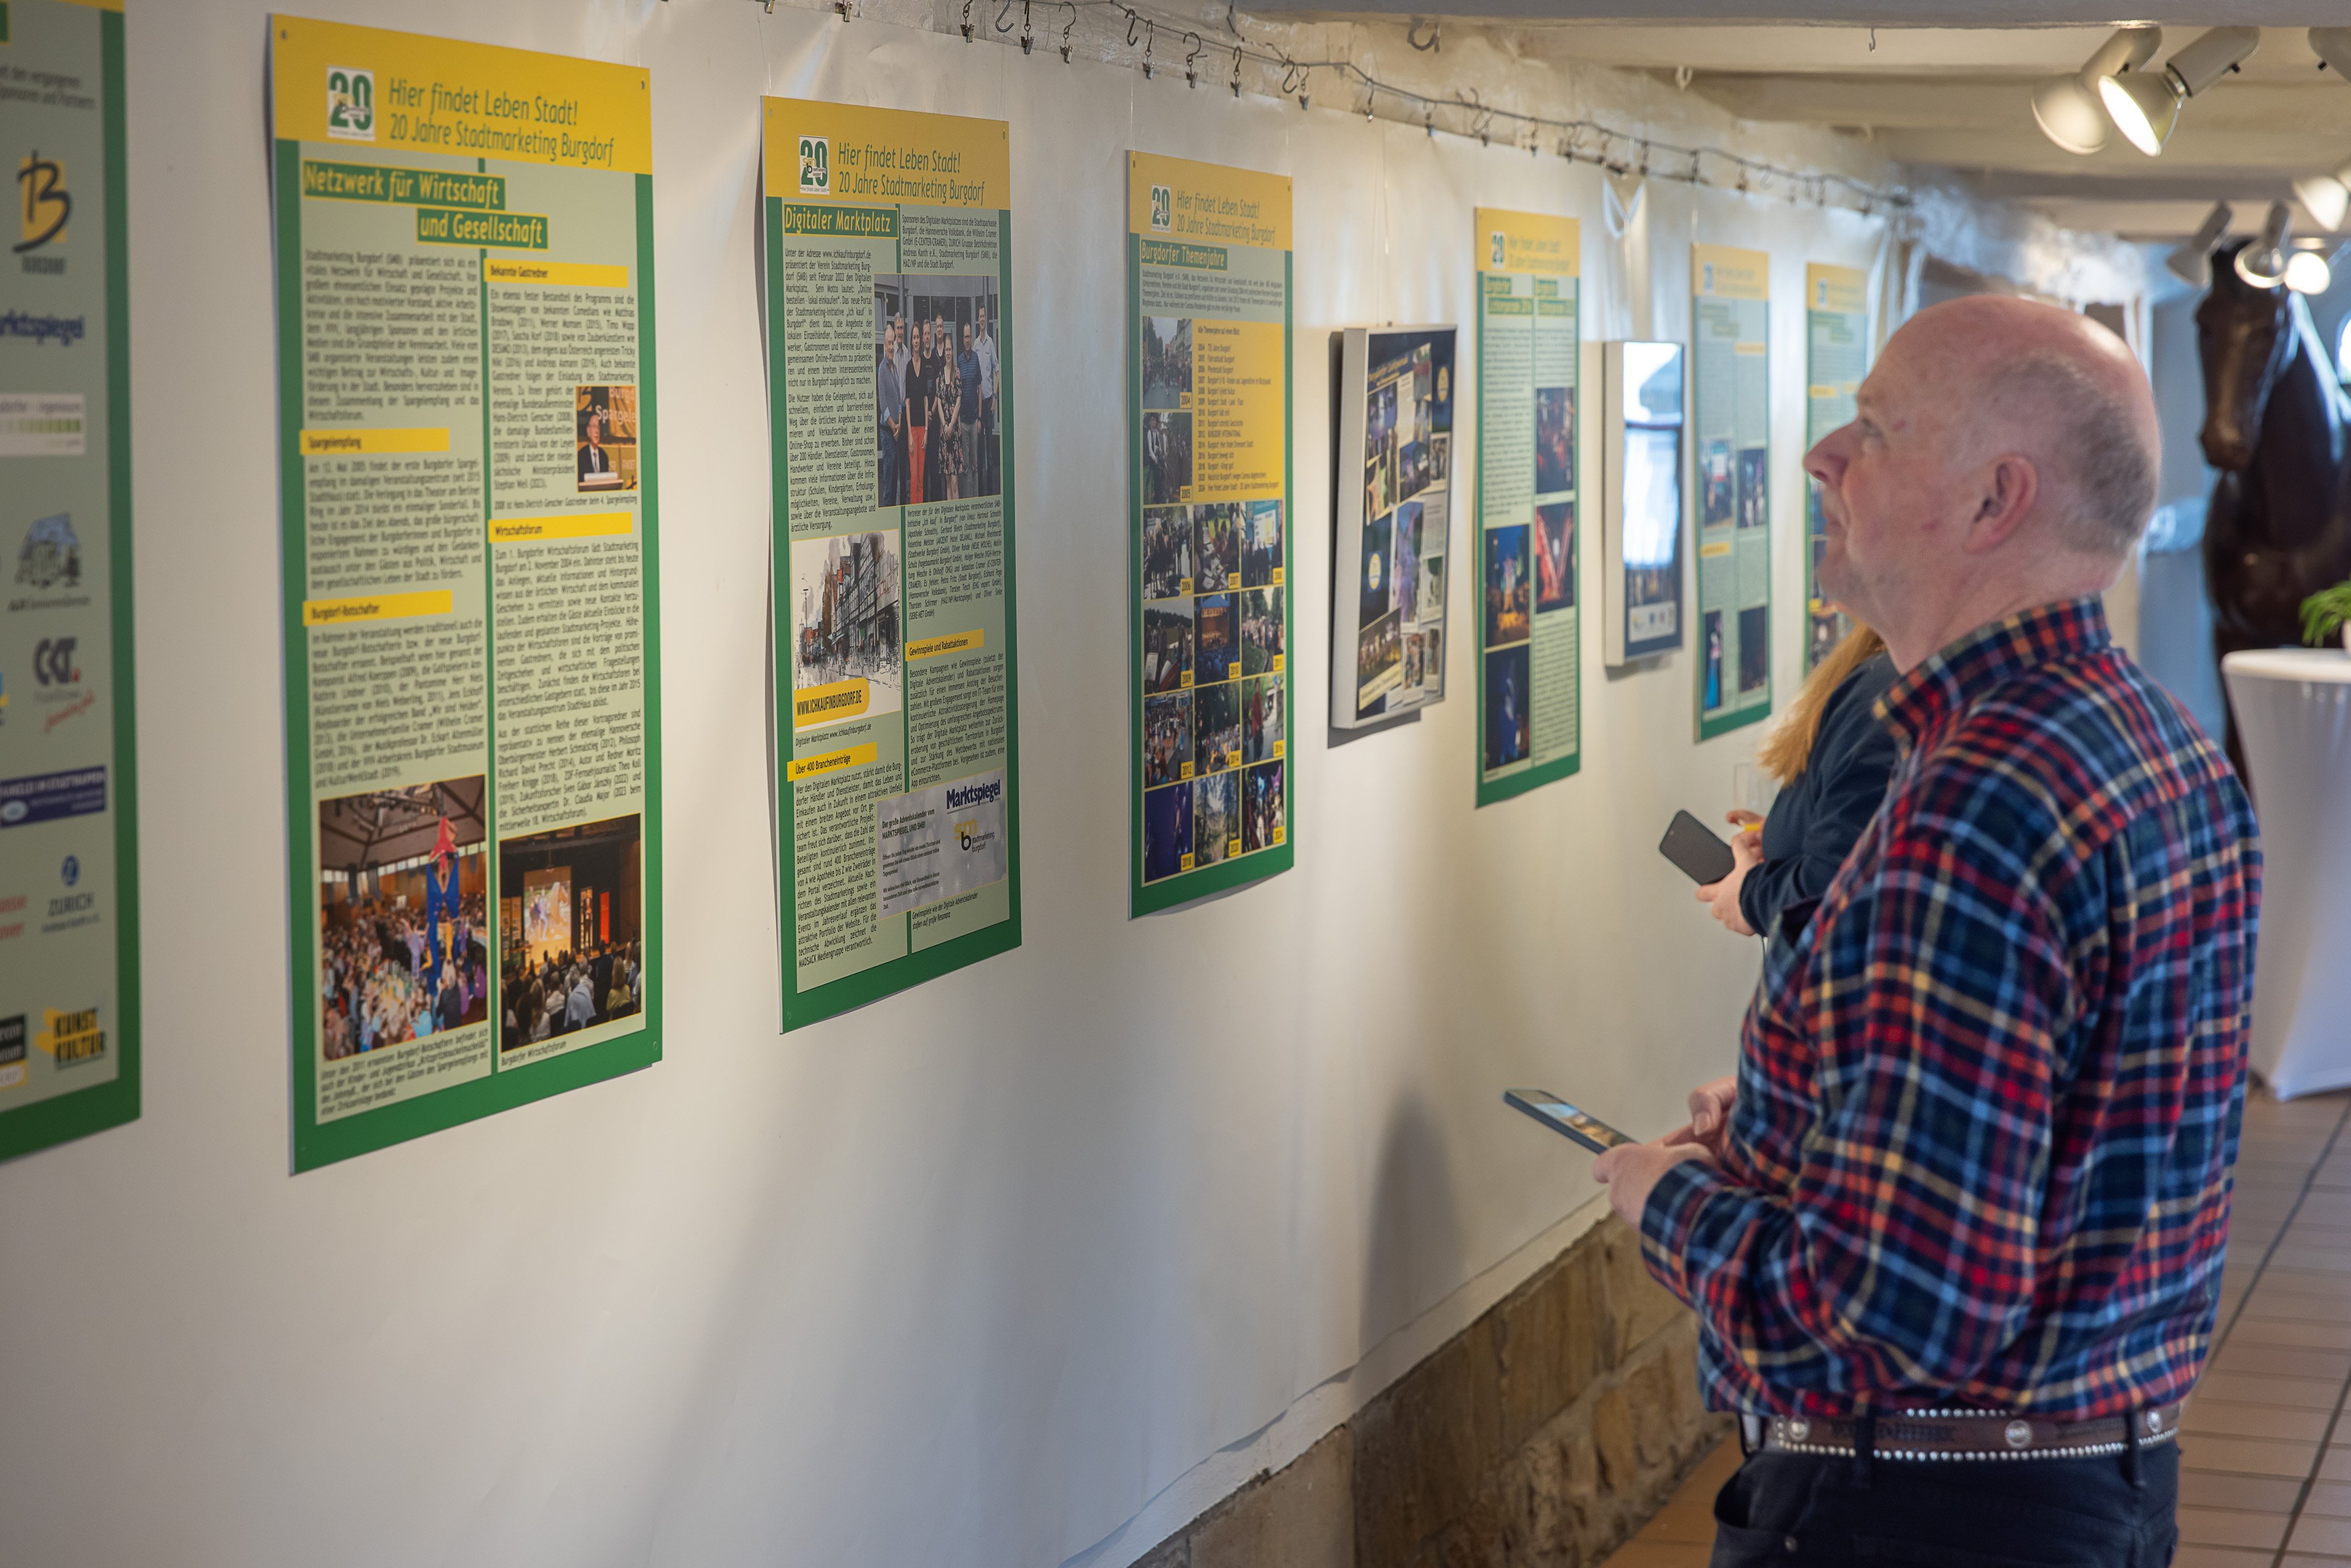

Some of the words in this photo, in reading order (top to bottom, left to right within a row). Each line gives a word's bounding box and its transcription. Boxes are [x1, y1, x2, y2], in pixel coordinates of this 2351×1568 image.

[389, 78, 424, 107] Hier
[430, 82, 479, 114] findet
[485, 90, 529, 119] Leben
[536, 96, 577, 125] Stadt!
[390, 113, 408, 140] 20
[411, 116, 450, 144] Jahre
[456, 120, 557, 161] Stadtmarketing
[561, 132, 614, 166] Burgdorf
[839, 142, 861, 165] Hier
[865, 144, 896, 169] findet
[900, 148, 929, 170] Leben
[932, 150, 960, 173] Stadt!
[305, 166, 384, 197] Netzwerk
[389, 171, 414, 201] für
[419, 174, 499, 207] Wirtschaft
[839, 171, 849, 192] 20
[853, 173, 878, 194] Jahre
[881, 174, 947, 203] Stadtmarketing
[950, 179, 985, 205] Burgdorf
[1177, 190, 1193, 209] Hier
[1195, 192, 1216, 213] findet
[1218, 197, 1237, 215] Leben
[1240, 199, 1259, 218] Stadt!
[420, 213, 448, 244] und
[453, 214, 543, 247] Gesellschaft
[785, 207, 832, 235] Digitaler
[836, 210, 890, 236] Marktplatz
[902, 214, 920, 223] Sponsoren
[926, 215, 941, 225] Digitalen
[941, 216, 961, 226] Marktplatzes
[974, 218, 997, 228] Stadtsparkasse
[1177, 213, 1185, 231] 20
[1186, 216, 1203, 234] Jahre
[1205, 217, 1249, 243] Stadtmarketing
[1252, 223, 1276, 245] Burgdorf
[785, 249, 796, 257] Unter
[806, 249, 821, 257] Adresse
[823, 249, 871, 260] www.ichkaufinburgdorf.de
[786, 260, 807, 270] präsentiert
[818, 261, 830, 269] Verein
[832, 262, 860, 272] Stadtmarketing
[862, 262, 871, 272] Burg-
[903, 259, 916, 267] HAZ/NP
[930, 260, 939, 268] Stadt
[939, 260, 955, 270] Burgdorf.
[1142, 242, 1180, 263] Burgdorfer
[1182, 246, 1224, 267] Themenjahre
[495, 525, 543, 536] Wirtschaftsforum
[909, 644, 933, 656] Gewinnspiele
[942, 638, 968, 649] Rabattaktionen
[796, 690, 862, 714] WWW.ICHKAUFINBURGDORF.DE
[796, 737, 810, 747] Digitaler
[811, 733, 829, 742] Marktplatz
[830, 722, 871, 737] www.ichkaufinburgdorf.de
[796, 763, 806, 774] Über
[815, 754, 851, 769] Brancheneinträge
[813, 779, 830, 791] Digitalen
[831, 774, 851, 786] Marktplatz
[851, 772, 862, 780] nutzt,
[863, 768, 874, 778] stärkt
[875, 766, 885, 774] damit
[892, 762, 902, 773] Burg-
[919, 774, 941, 785] einzurichten.
[947, 779, 1000, 809] Marktspiegel
[882, 826, 909, 839] MARKTSPIEGEL
[917, 821, 926, 829] SMB!
[888, 818, 899, 828] große
[900, 811, 927, 823] Adventskalender
[972, 832, 995, 846] stadtmarketing
[972, 842, 986, 852] burgdorf
[913, 907, 932, 919] Gewinnspiele
[943, 899, 955, 910] Digitale
[955, 892, 978, 904] Adventskalender
[913, 920, 922, 930] stoßen
[929, 915, 937, 926] große
[937, 912, 950, 920] Resonanz
[799, 954, 817, 967] MADSACK
[817, 947, 843, 961] Mediengruppe
[845, 936, 872, 951] verantwortlich.
